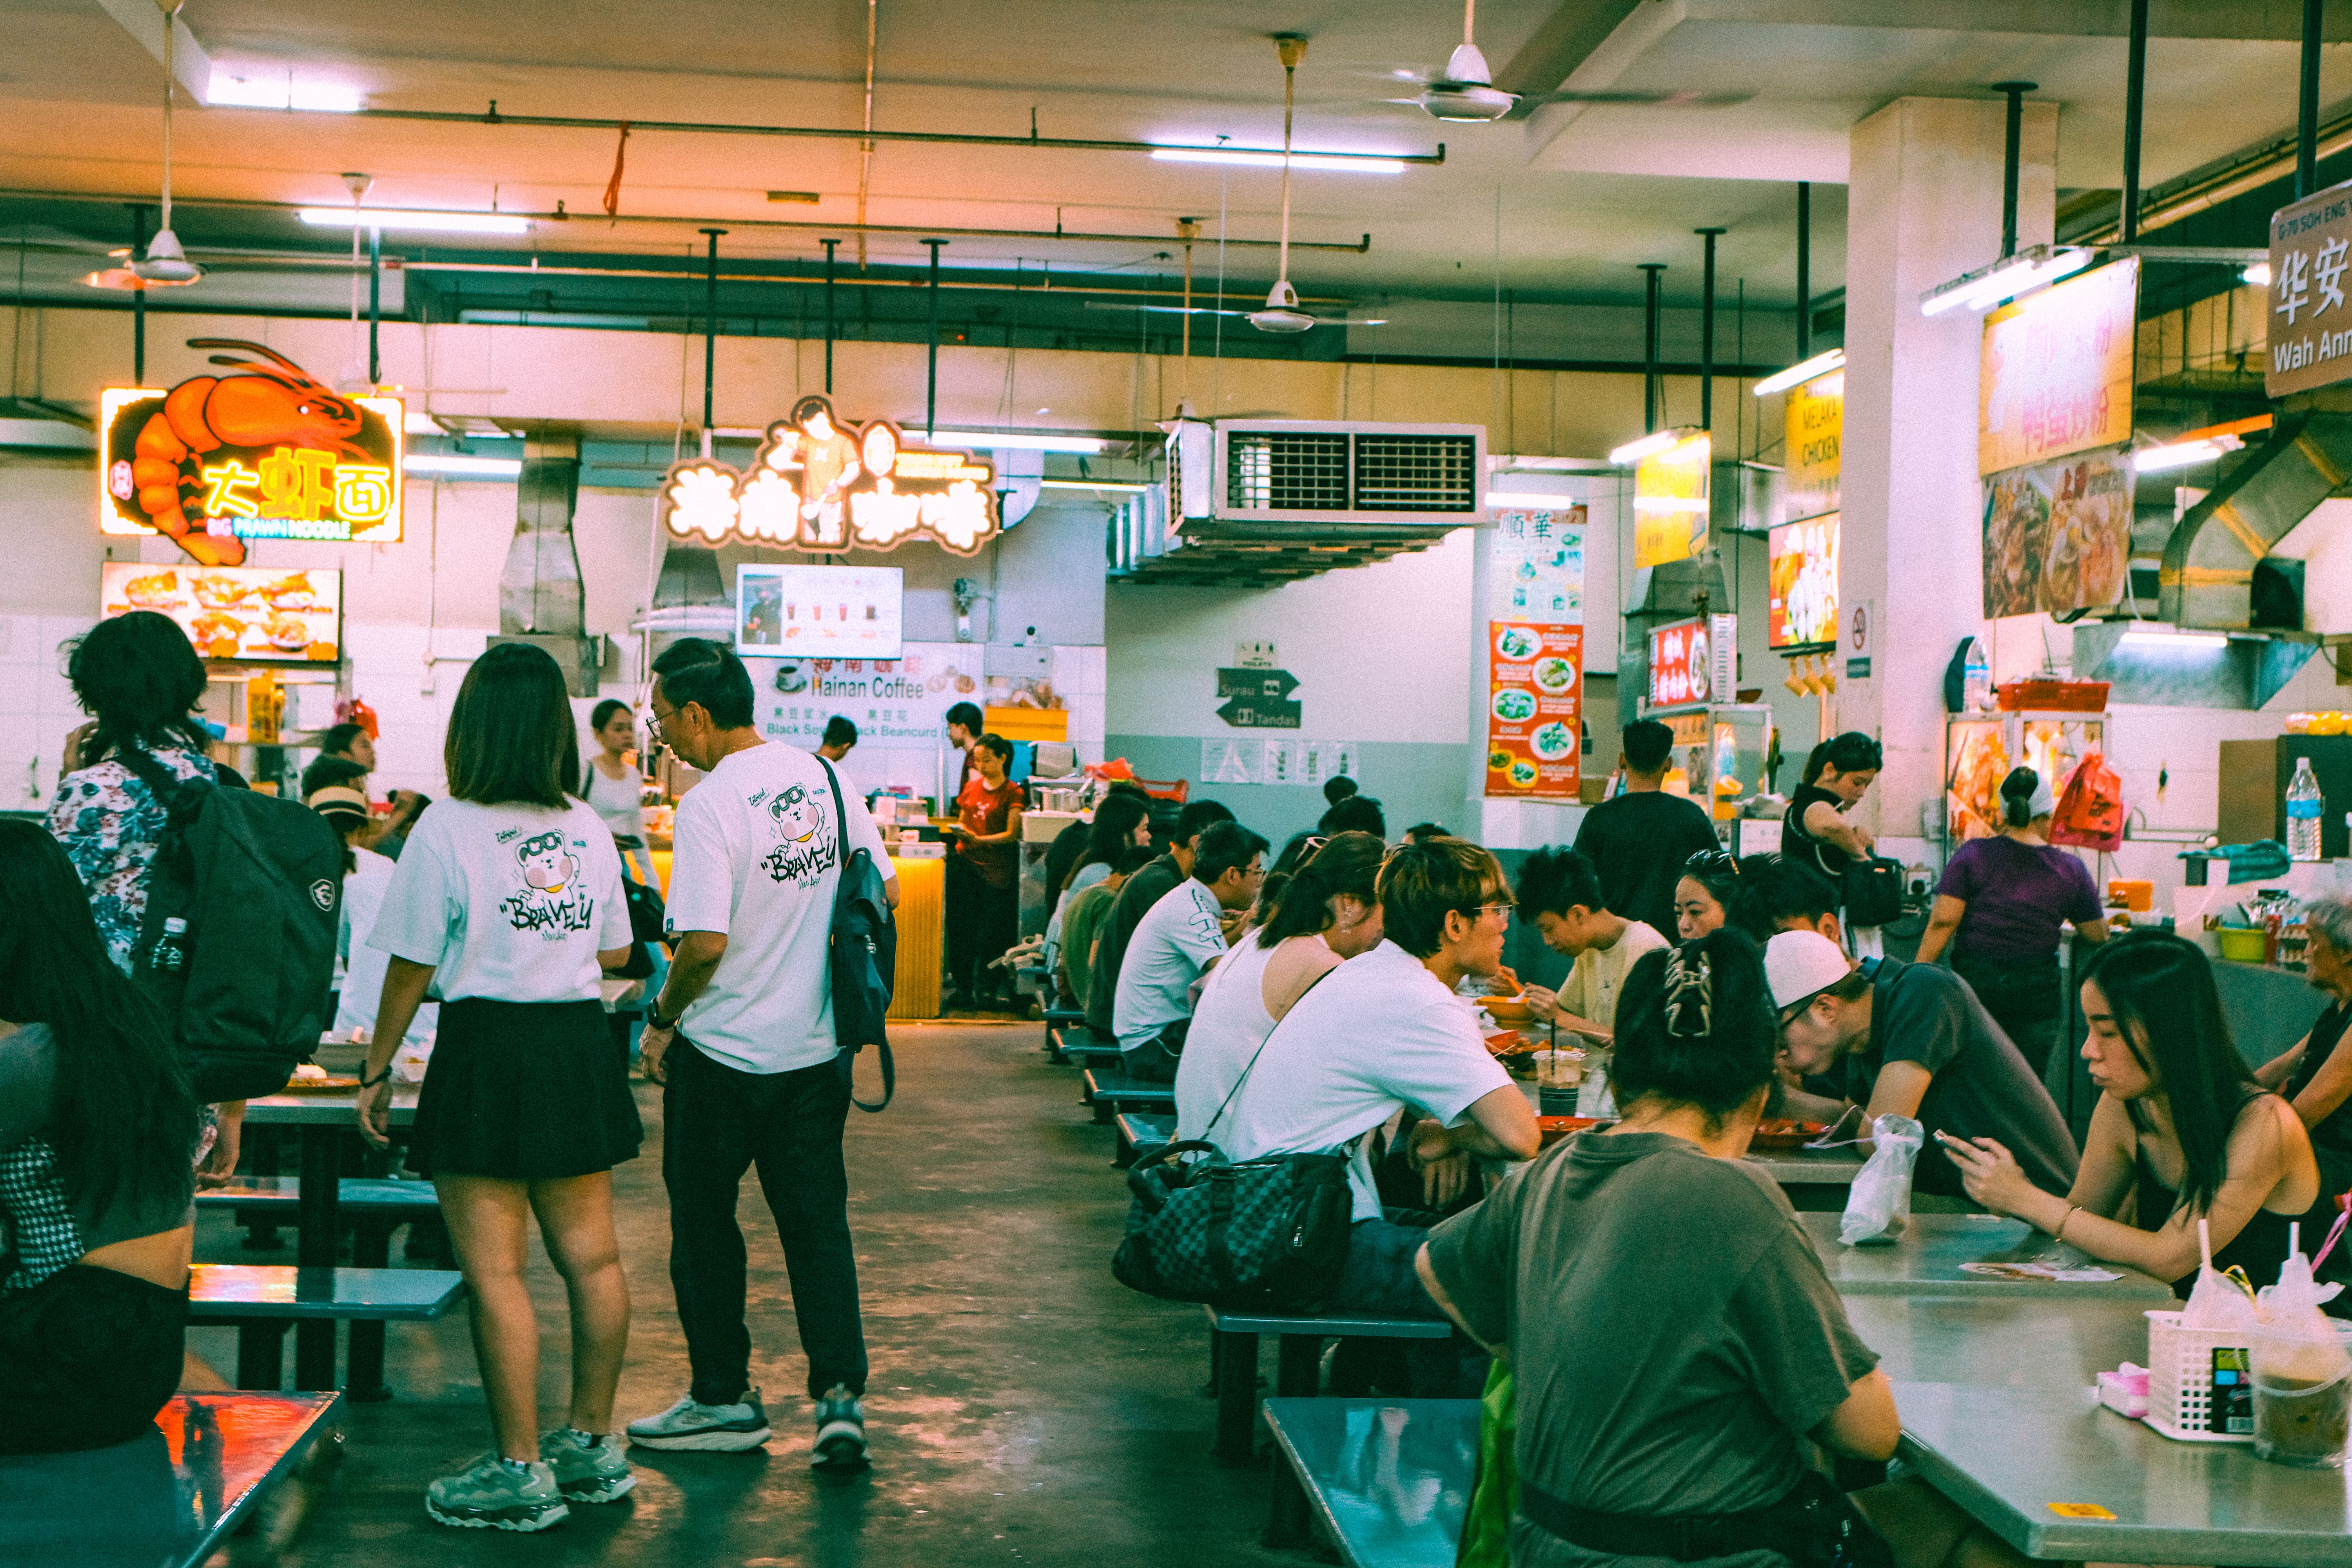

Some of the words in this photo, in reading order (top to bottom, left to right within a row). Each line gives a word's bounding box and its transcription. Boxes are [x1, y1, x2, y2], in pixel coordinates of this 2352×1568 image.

[2324, 199, 2347, 223] ENG
[2276, 237, 2349, 326] 华安
[2274, 336, 2314, 374] Wah
[1803, 397, 1839, 430] MELAKA
[1803, 435, 1840, 466] CHICKEN
[203, 446, 391, 521] 大虾面
[206, 517, 232, 536] BIG
[233, 517, 288, 538] PRAWN
[287, 519, 351, 540] NOODLE
[812, 676, 866, 697] Hainan
[873, 676, 924, 698] Coffee
[1221, 684, 1255, 696] Surau
[767, 723, 799, 735] Black
[881, 726, 937, 739] Beancurd
